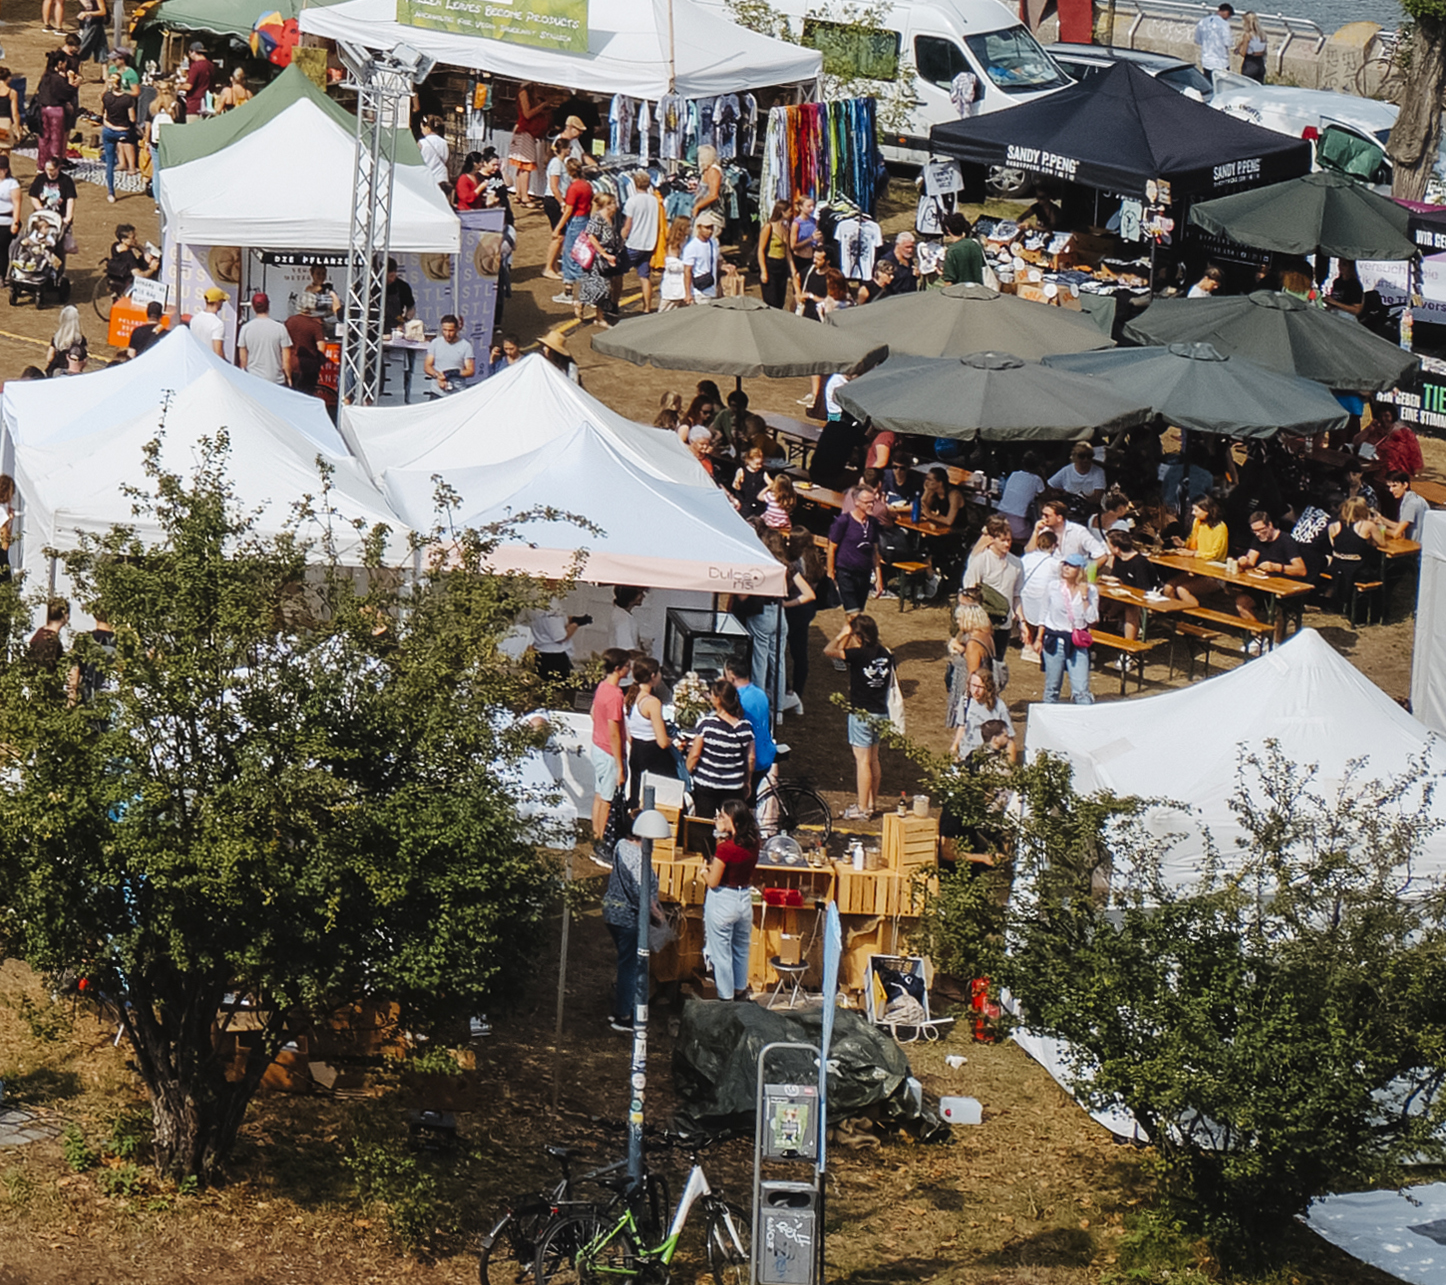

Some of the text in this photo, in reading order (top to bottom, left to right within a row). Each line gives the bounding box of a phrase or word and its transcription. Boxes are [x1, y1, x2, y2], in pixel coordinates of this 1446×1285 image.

[1006, 144, 1041, 164] SANDY
[1213, 162, 1237, 181] SANDY
[1416, 229, 1434, 246] WIR
[274, 255, 295, 264] DIE
[1400, 406, 1419, 422] EINE
